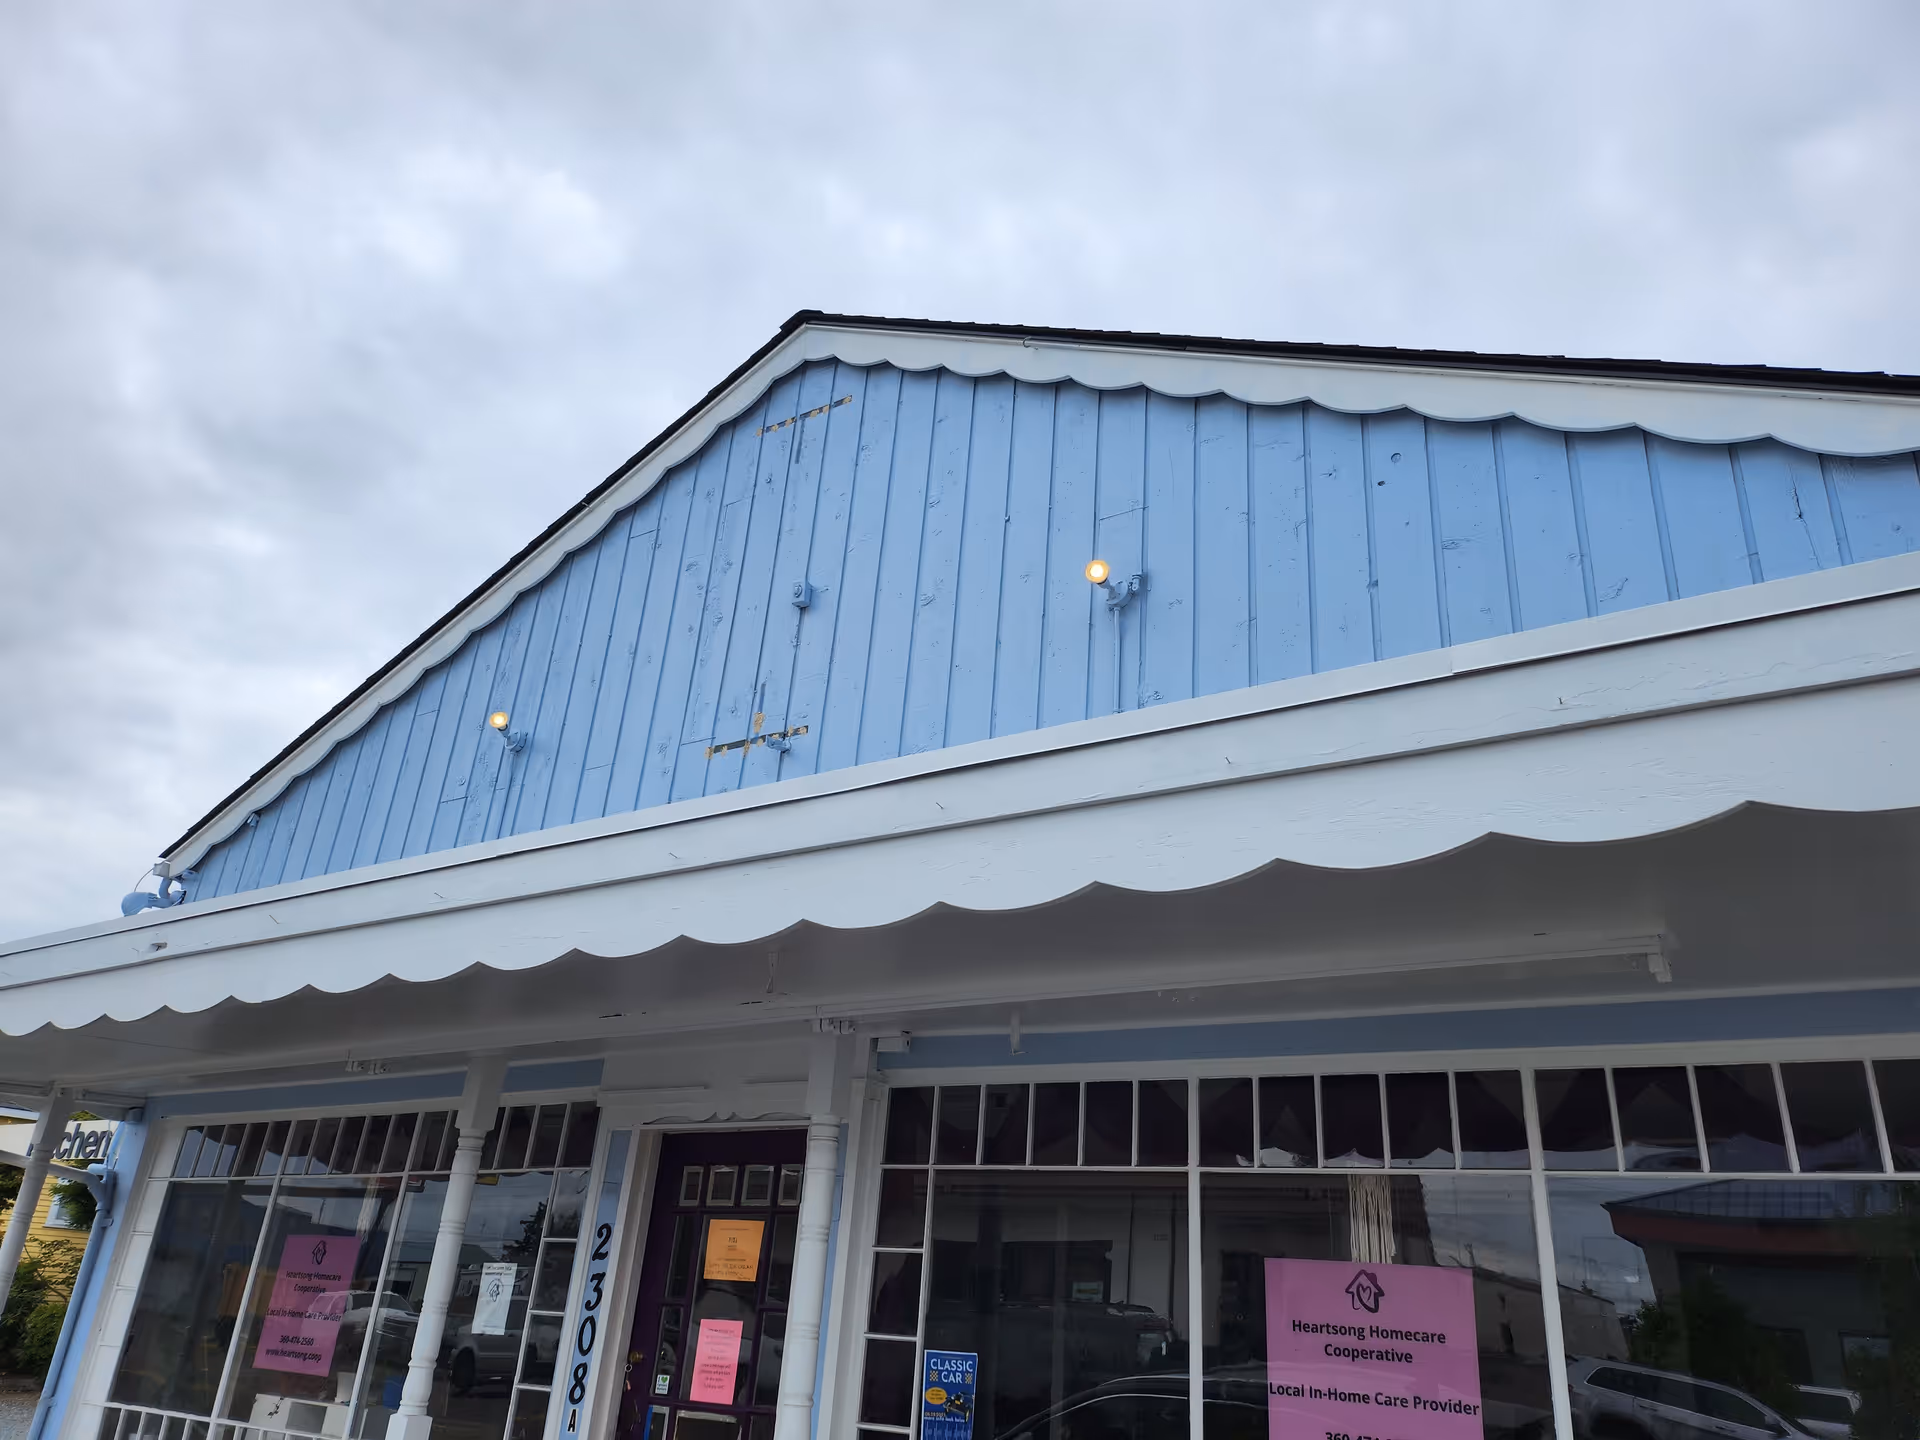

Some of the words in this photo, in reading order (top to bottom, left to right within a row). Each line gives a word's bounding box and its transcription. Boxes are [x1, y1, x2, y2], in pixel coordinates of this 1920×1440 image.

[286, 1271, 313, 1281] Heartsong
[313, 1271, 341, 1281] Homecare
[294, 1284, 326, 1294] Cooperative
[1292, 1320, 1365, 1340] Heartsong
[1369, 1325, 1446, 1344] Homecare
[1324, 1344, 1413, 1363] Cooperative
[930, 1358, 973, 1372] CLASSIC
[941, 1371, 962, 1384] CAR
[1269, 1382, 1305, 1397] Local
[1309, 1386, 1370, 1404] In-Home
[1375, 1392, 1408, 1408] Care
[1413, 1396, 1480, 1416] Provider
